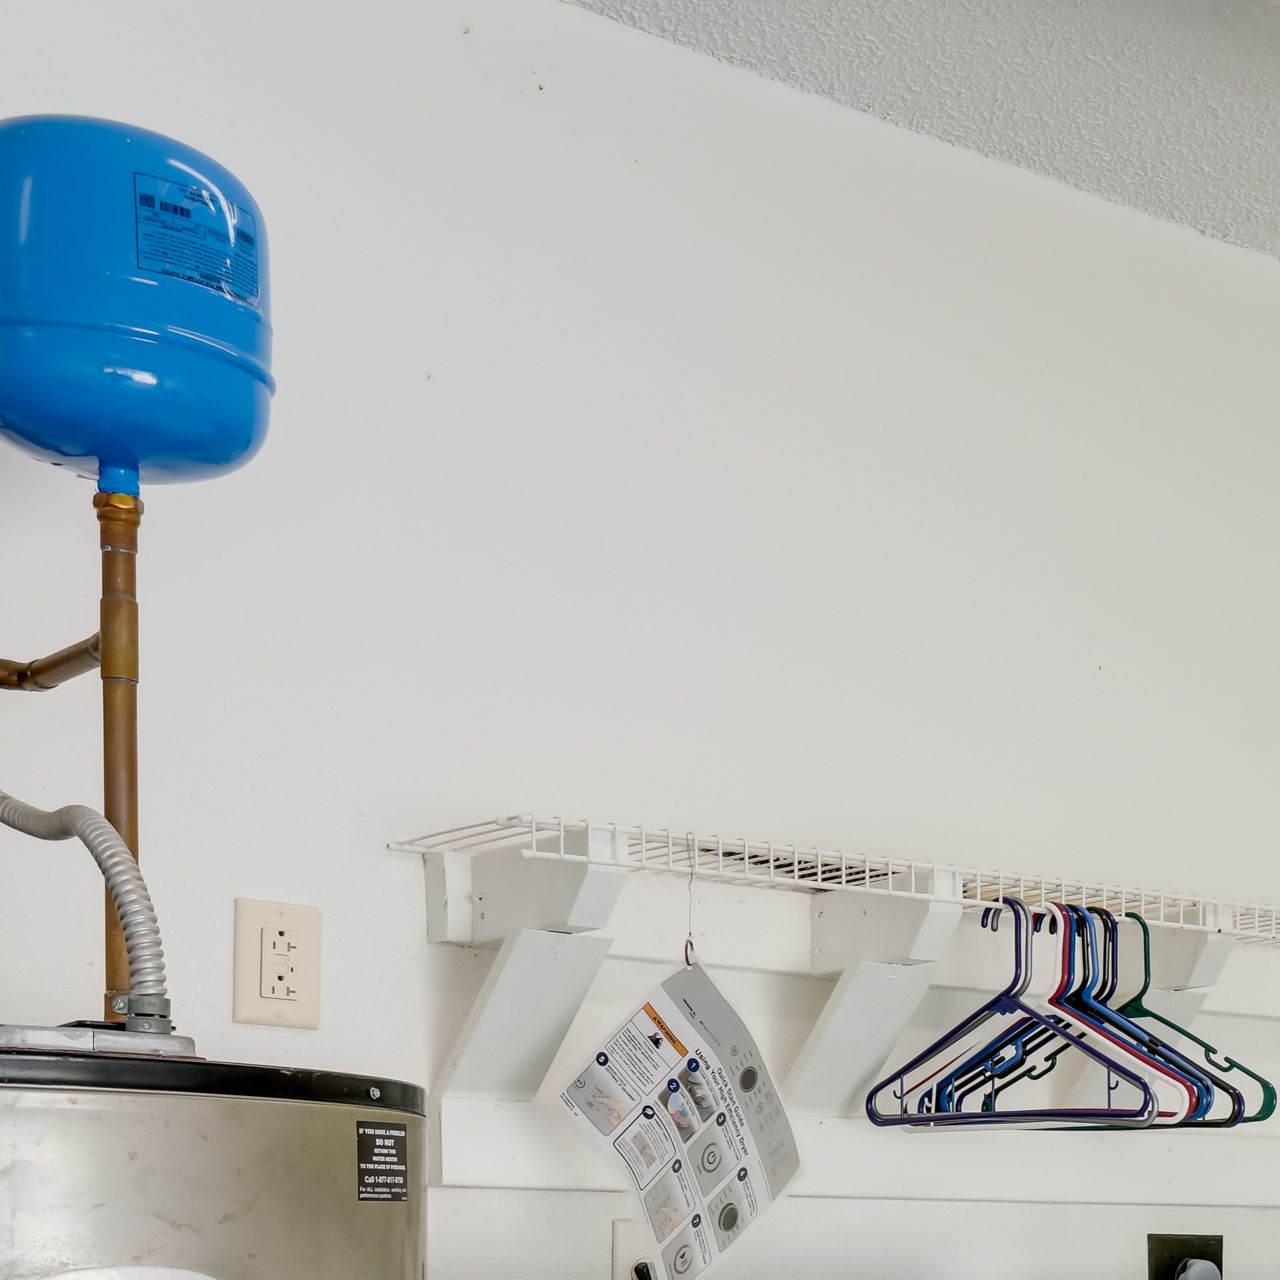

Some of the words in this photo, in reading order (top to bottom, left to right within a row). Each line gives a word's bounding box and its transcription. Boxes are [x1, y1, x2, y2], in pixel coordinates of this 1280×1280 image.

[695, 1048, 711, 1071] Using
[710, 1068, 720, 1087] Your
[719, 1086, 727, 1104] High
[725, 1103, 740, 1138] Efficiency
[739, 1137, 749, 1156] Dryer
[717, 1067, 728, 1089] Quick
[728, 1088, 736, 1108] Start
[733, 1106, 745, 1128] Guide
